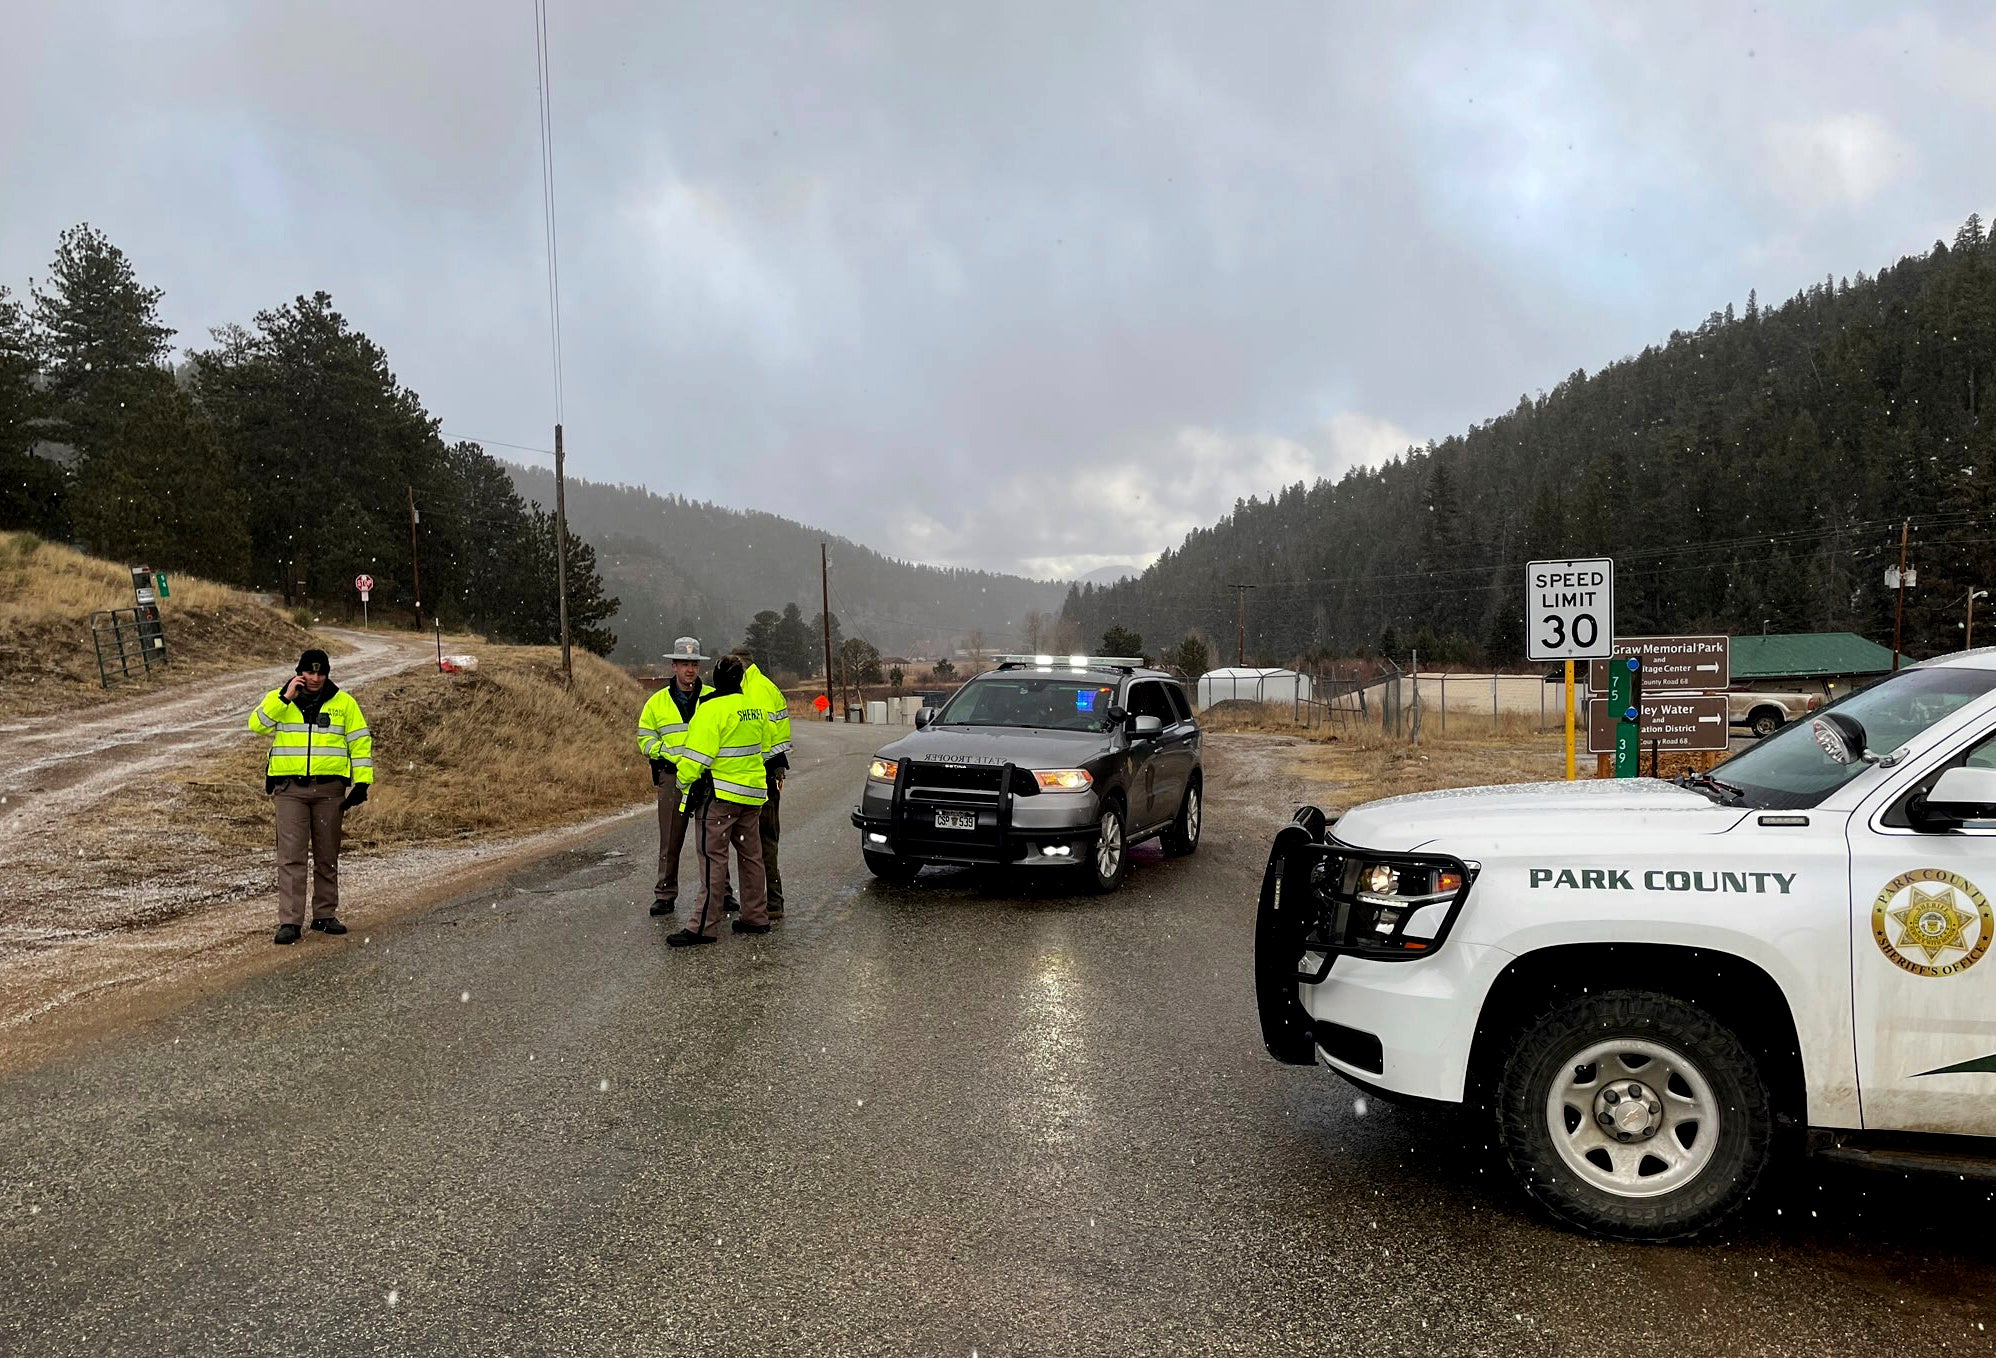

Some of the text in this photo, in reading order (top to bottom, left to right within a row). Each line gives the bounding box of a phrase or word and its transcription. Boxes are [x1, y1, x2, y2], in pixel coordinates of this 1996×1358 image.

[1536, 572, 1603, 588] SPEED
[1543, 592, 1596, 607] LIMIT
[1541, 613, 1598, 648] 30
[1613, 642, 1723, 655] Graw Memorial Park
[1642, 664, 1691, 674] itage Center
[1641, 705, 1694, 717] ley Water
[1641, 724, 1696, 733] ation District
[1662, 737, 1678, 745] Road
[959, 816, 973, 828] 539
[1530, 868, 1797, 894] PARK COUNTY
[1878, 869, 1987, 907] PARK COUNTY
[1880, 937, 1986, 976] SHERIFF'S OFFICE
